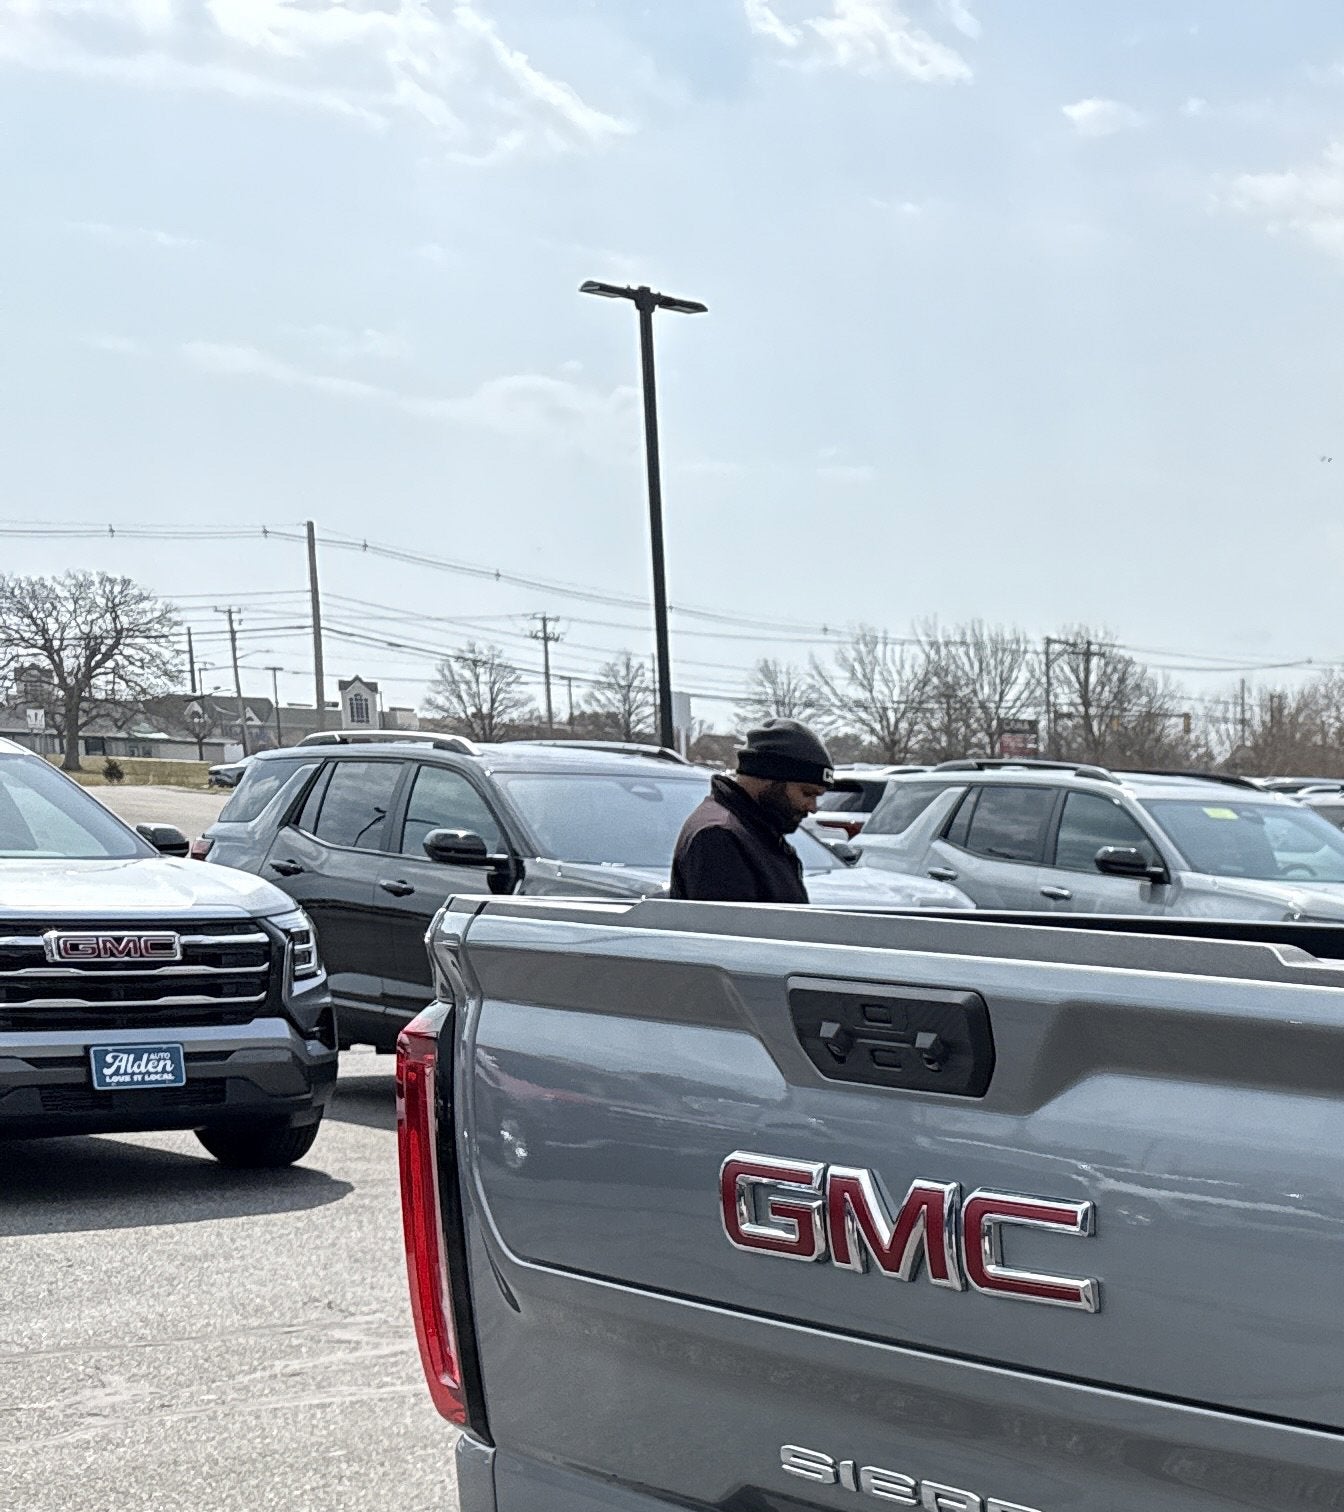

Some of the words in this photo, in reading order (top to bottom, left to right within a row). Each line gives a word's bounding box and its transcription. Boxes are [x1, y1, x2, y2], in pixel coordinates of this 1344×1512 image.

[59, 936, 177, 958] GMC
[103, 1052, 175, 1076] Alden
[149, 1052, 171, 1060] AUTO
[105, 1074, 131, 1083] LOVE
[720, 1150, 1101, 1313] GMC
